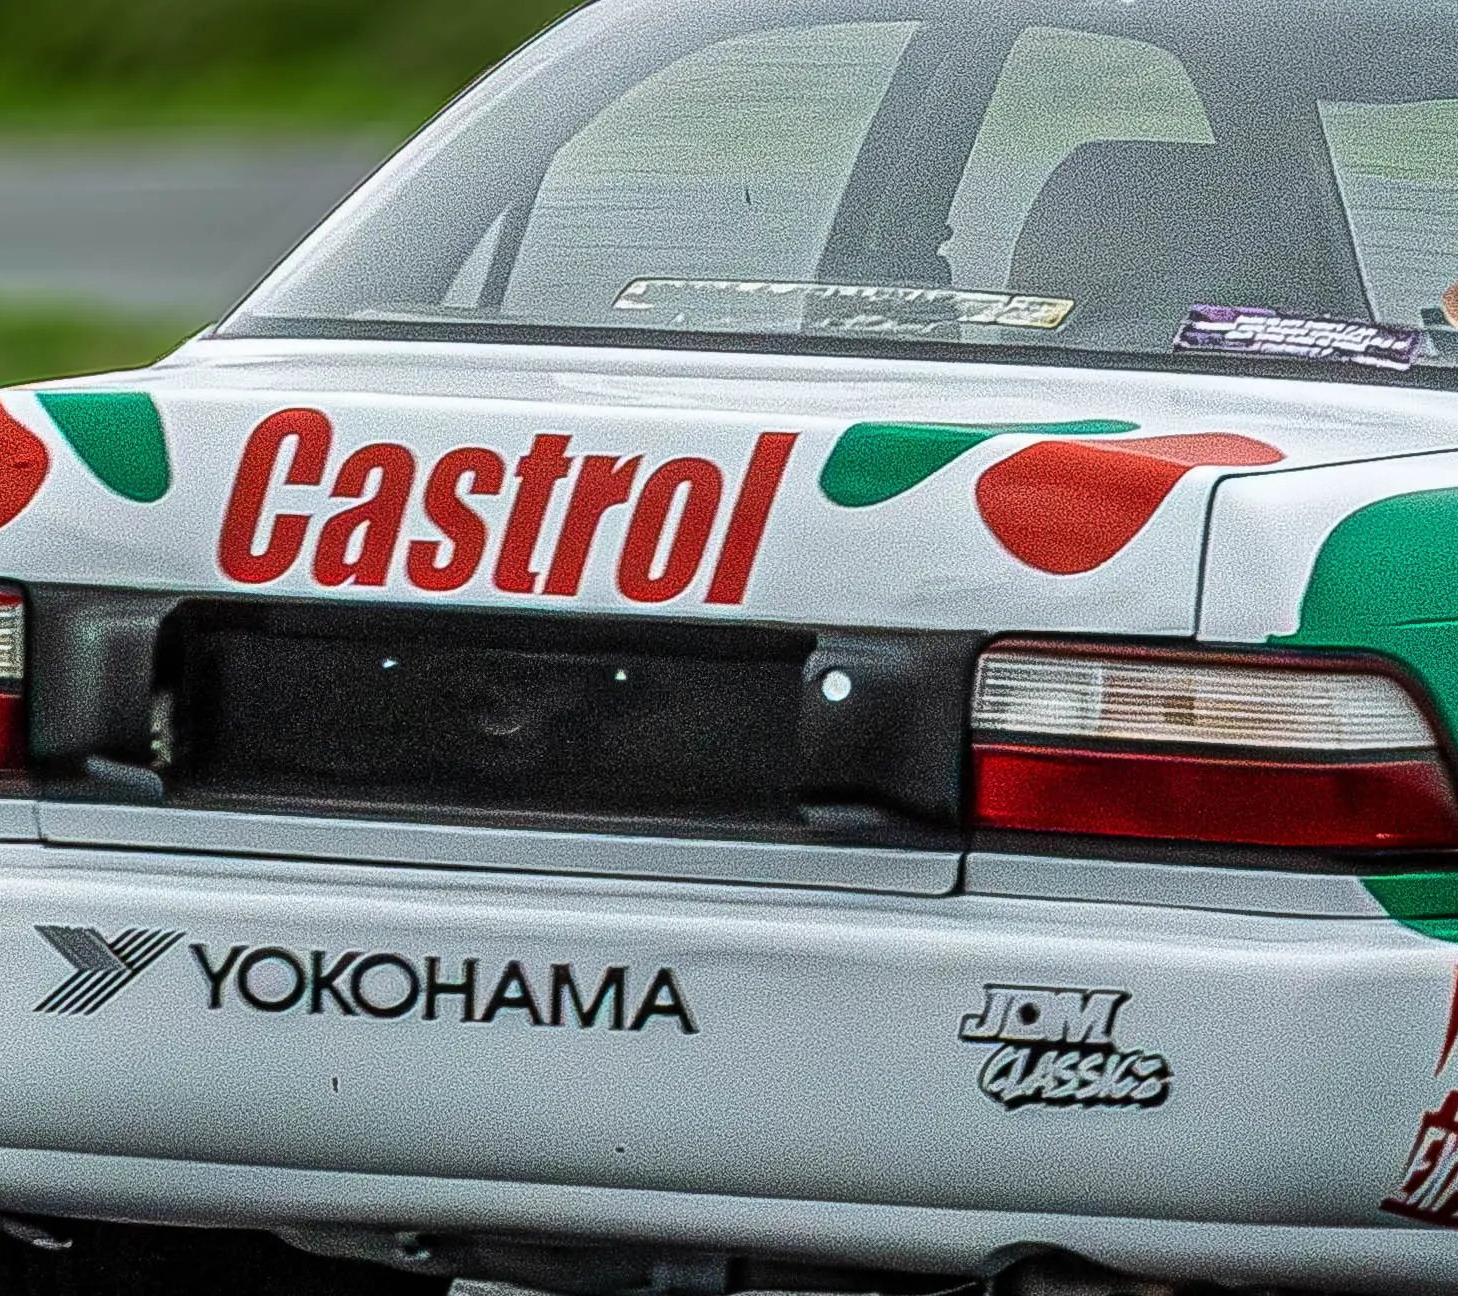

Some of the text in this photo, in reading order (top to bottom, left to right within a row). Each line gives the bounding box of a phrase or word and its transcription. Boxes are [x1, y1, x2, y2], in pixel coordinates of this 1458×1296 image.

[217, 407, 801, 604] Castrol
[189, 943, 699, 1035] YOKOHAMA
[958, 983, 1132, 1046] JDM
